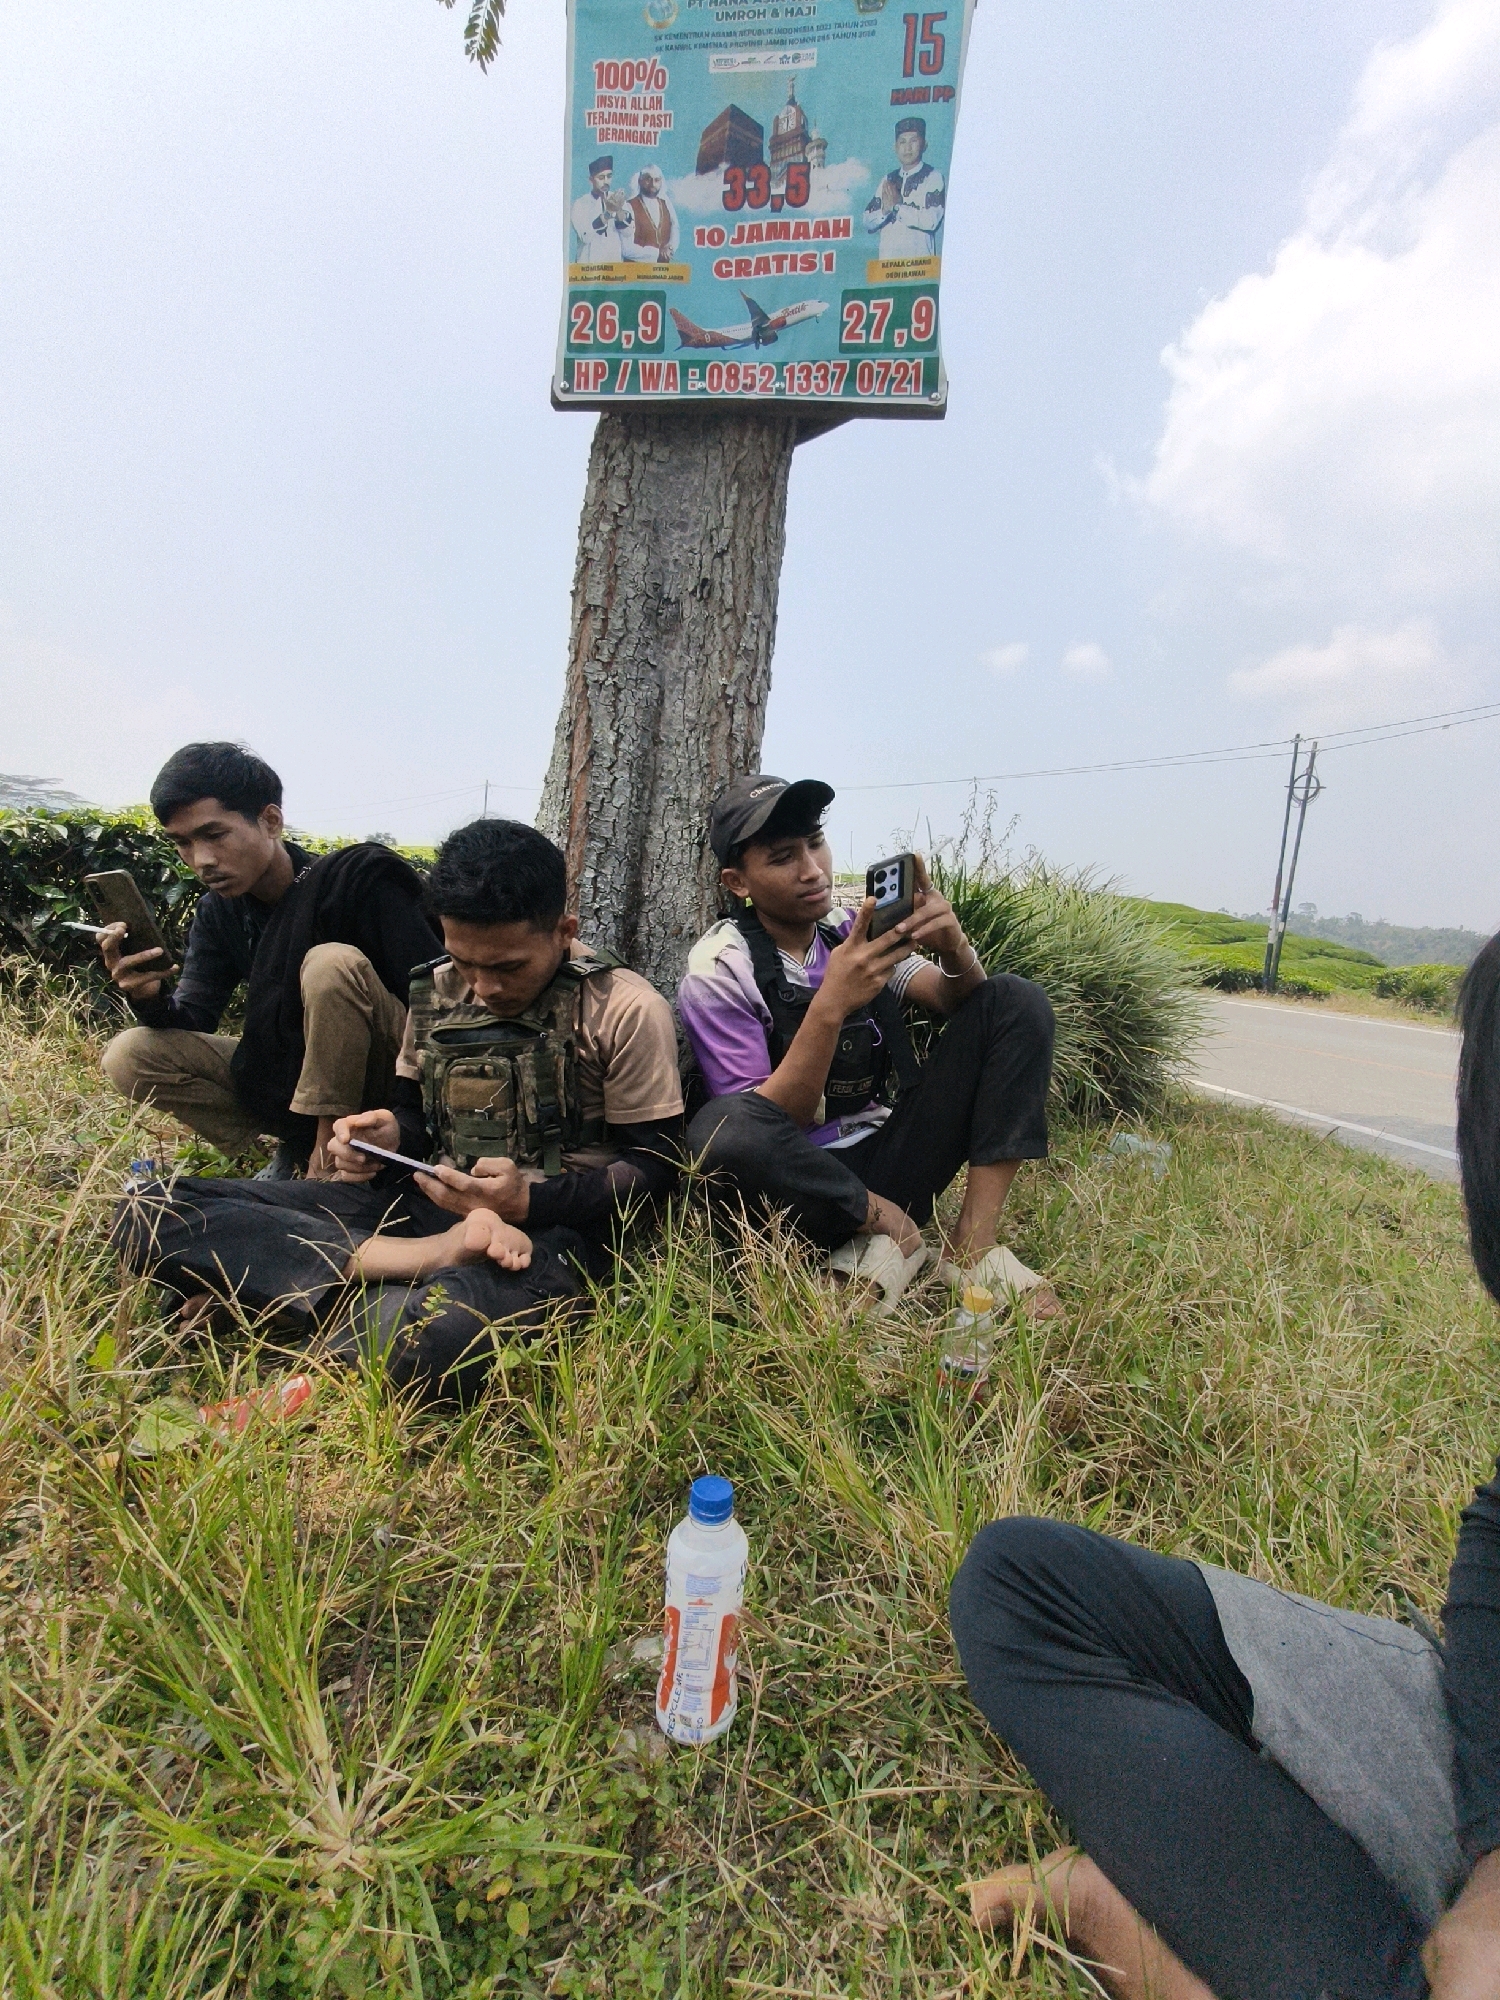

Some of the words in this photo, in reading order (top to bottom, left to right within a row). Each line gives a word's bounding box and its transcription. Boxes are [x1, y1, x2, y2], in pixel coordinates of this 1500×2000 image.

[716, 9, 766, 21] UMROH
[771, 8, 780, 18] &
[784, 6, 816, 18] HAJI
[694, 42, 728, 50] KEMENAG
[729, 39, 762, 49] PROVINSI
[765, 38, 787, 46] JAMBI
[832, 31, 858, 40] TAHUN
[774, 26, 814, 35] INDONESIA
[834, 21, 859, 30] TAHUN
[902, 11, 947, 78] 15
[594, 58, 667, 92] 100%
[596, 94, 627, 110] INSYA
[630, 96, 663, 111] ALLAH
[890, 86, 932, 106] HARI
[932, 85, 956, 102] PP
[586, 111, 639, 127] TERJAMIN
[642, 113, 672, 128] PASTI
[598, 127, 660, 145] BERANGKAT
[722, 161, 811, 213] 33,5
[694, 227, 726, 247] 10
[730, 218, 852, 246] JAMAAH
[713, 252, 818, 279] GRATIS
[823, 252, 835, 272] 1
[882, 260, 906, 268] KEPALA
[571, 302, 661, 348] 26,9
[843, 298, 936, 347] 27,9
[575, 360, 607, 392] HP
[616, 360, 632, 393] /
[640, 359, 680, 393] WA
[707, 361, 776, 394] 0852
[784, 360, 848, 394] 1337
[856, 359, 922, 395] 0721
[666, 1687, 682, 1736] RECYCLE
